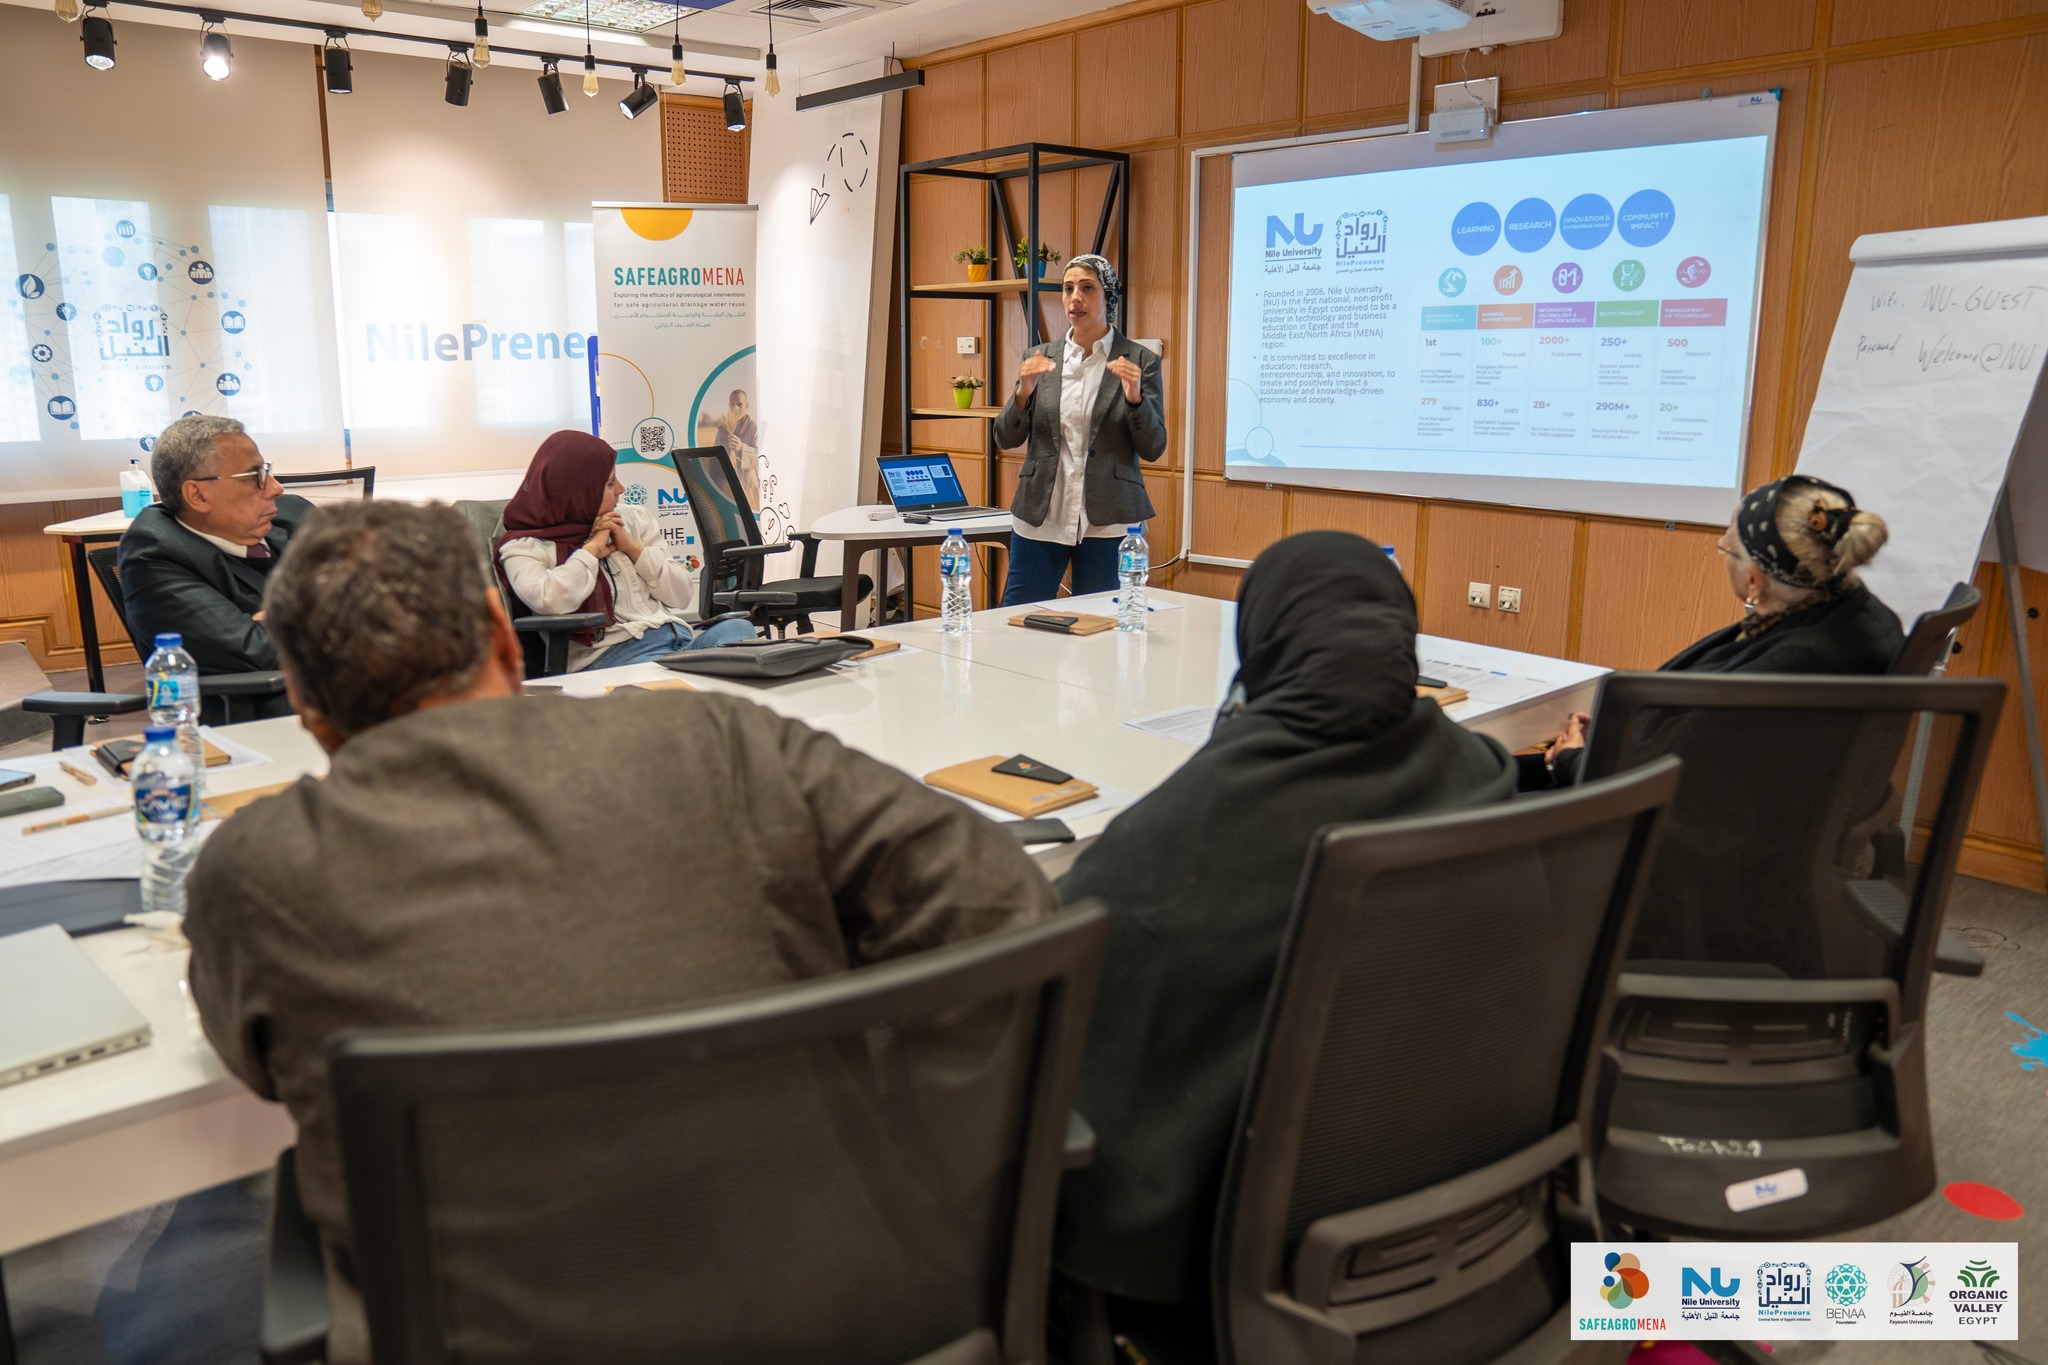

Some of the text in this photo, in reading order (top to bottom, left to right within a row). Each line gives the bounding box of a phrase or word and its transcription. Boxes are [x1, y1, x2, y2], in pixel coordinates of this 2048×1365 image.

[1563, 215, 1604, 223] INNOVATION
[1622, 212, 1670, 222] COMMUNITY
[1266, 212, 1324, 248] NU
[1457, 225, 1495, 234] LEARNING
[1508, 221, 1552, 231] RESEARCH
[1630, 222, 1660, 230] IMPACT
[1265, 246, 1322, 258] Nile University
[1335, 259, 1385, 267] NilePreneurs
[614, 267, 745, 286] SAFEAGROMENA
[1264, 289, 1294, 298] Founded
[1305, 288, 1326, 297] 2006,
[1328, 287, 1342, 296] Nile
[1344, 285, 1383, 295] University
[1263, 298, 1280, 307] (NU)
[1289, 298, 1301, 306] the
[1303, 297, 1317, 305] first
[1319, 295, 1351, 304] national,
[1354, 293, 1393, 302] non-profit
[1263, 307, 1297, 315] university
[1308, 305, 1328, 314] Egypt
[1330, 303, 1368, 312] conceived
[1370, 303, 1378, 311] to
[1380, 302, 1390, 311] be
[1262, 315, 1285, 323] leader
[1296, 313, 1336, 323] technology
[1338, 312, 1352, 320] and
[1354, 312, 1387, 320] business
[107, 312, 155, 341] رواد
[1262, 323, 1297, 331] education
[1308, 322, 1328, 331] Egypt
[1346, 321, 1359, 329] the
[1262, 329, 1383, 340] Middle East/North Africa (MENA)
[1425, 338, 1437, 346] 1st
[1538, 336, 1570, 344] 2000+
[1600, 337, 1627, 346] 250+
[1667, 338, 1688, 347] 500
[100, 335, 170, 361] النيل
[1262, 341, 1286, 350] region.
[1277, 353, 1316, 361] committed
[1328, 352, 1366, 360] excellence
[1368, 352, 1375, 360] in
[1261, 362, 1333, 370] education, research,
[1260, 370, 1324, 379] entrepreneurship,
[1326, 370, 1340, 378] and
[1343, 370, 1385, 378] innovation,
[1299, 379, 1333, 387] positively
[1336, 379, 1361, 387] impact
[1316, 387, 1384, 396] knowledge-driven
[1293, 396, 1307, 404] and
[1308, 396, 1336, 405] society.
[1420, 397, 1437, 406] 279
[1477, 399, 1500, 407] 830+
[1532, 400, 1551, 409] 2B+
[1596, 402, 1630, 411] 290M+
[1659, 403, 1679, 412] 20+
[658, 488, 688, 505] NU
